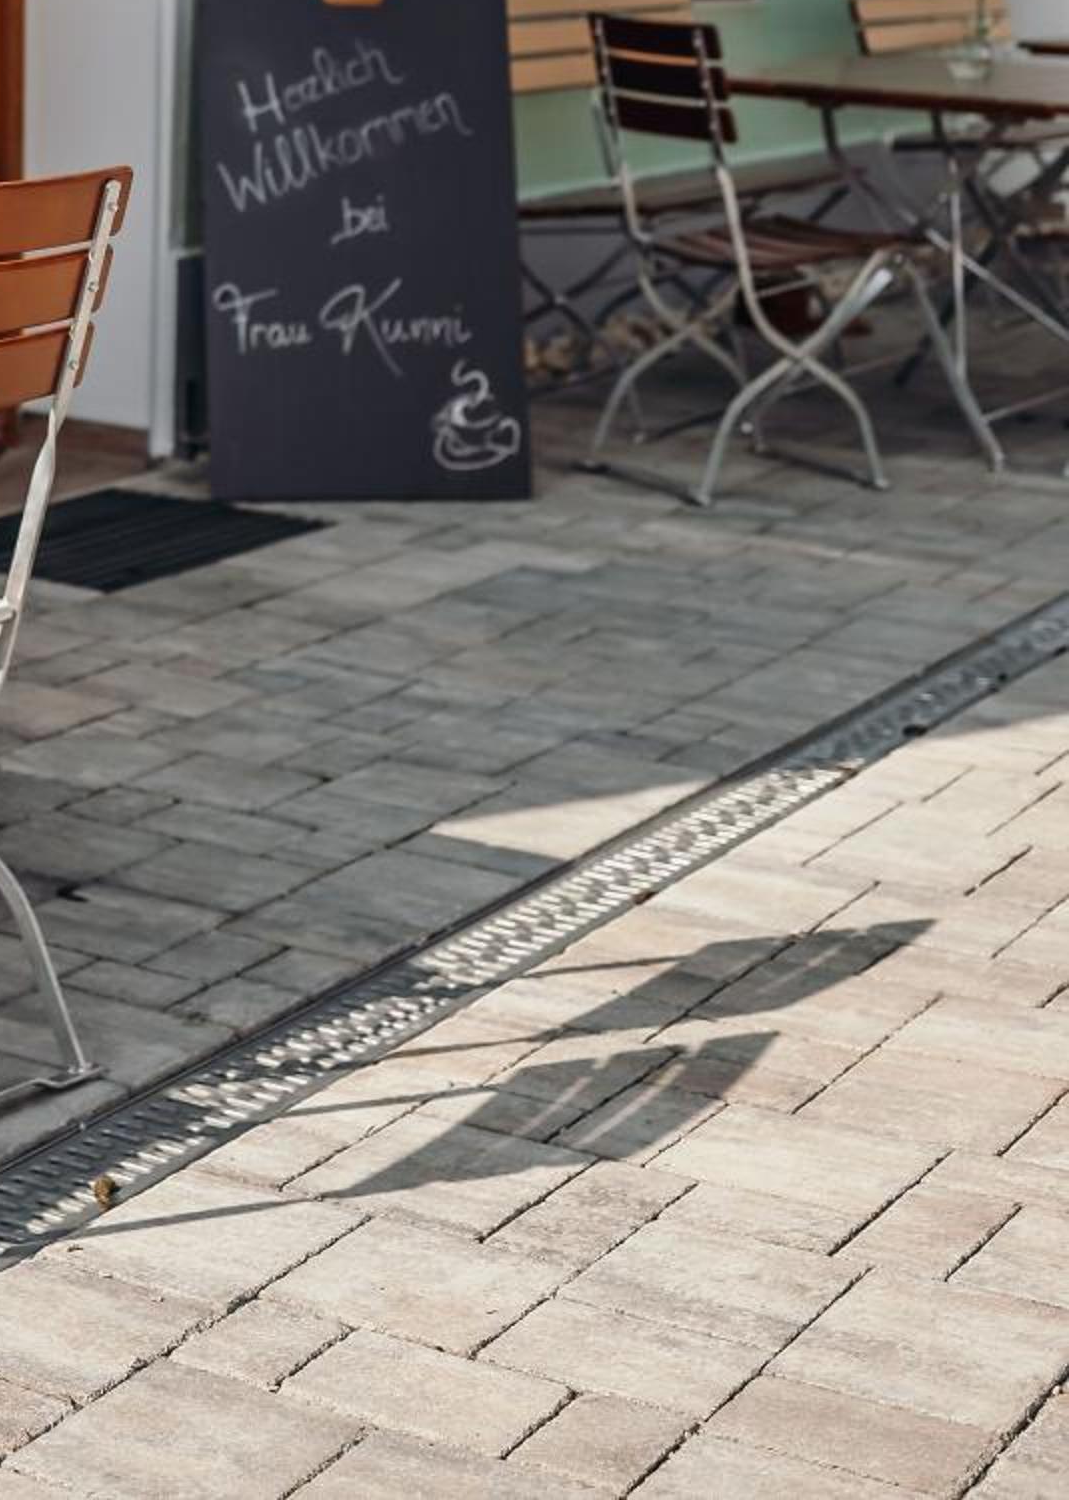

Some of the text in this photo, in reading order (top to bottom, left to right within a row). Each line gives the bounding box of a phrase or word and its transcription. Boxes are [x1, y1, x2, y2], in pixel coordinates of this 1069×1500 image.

[216, 92, 474, 213] Willkommen
[329, 194, 390, 246] bei
[211, 282, 312, 355] Frau
